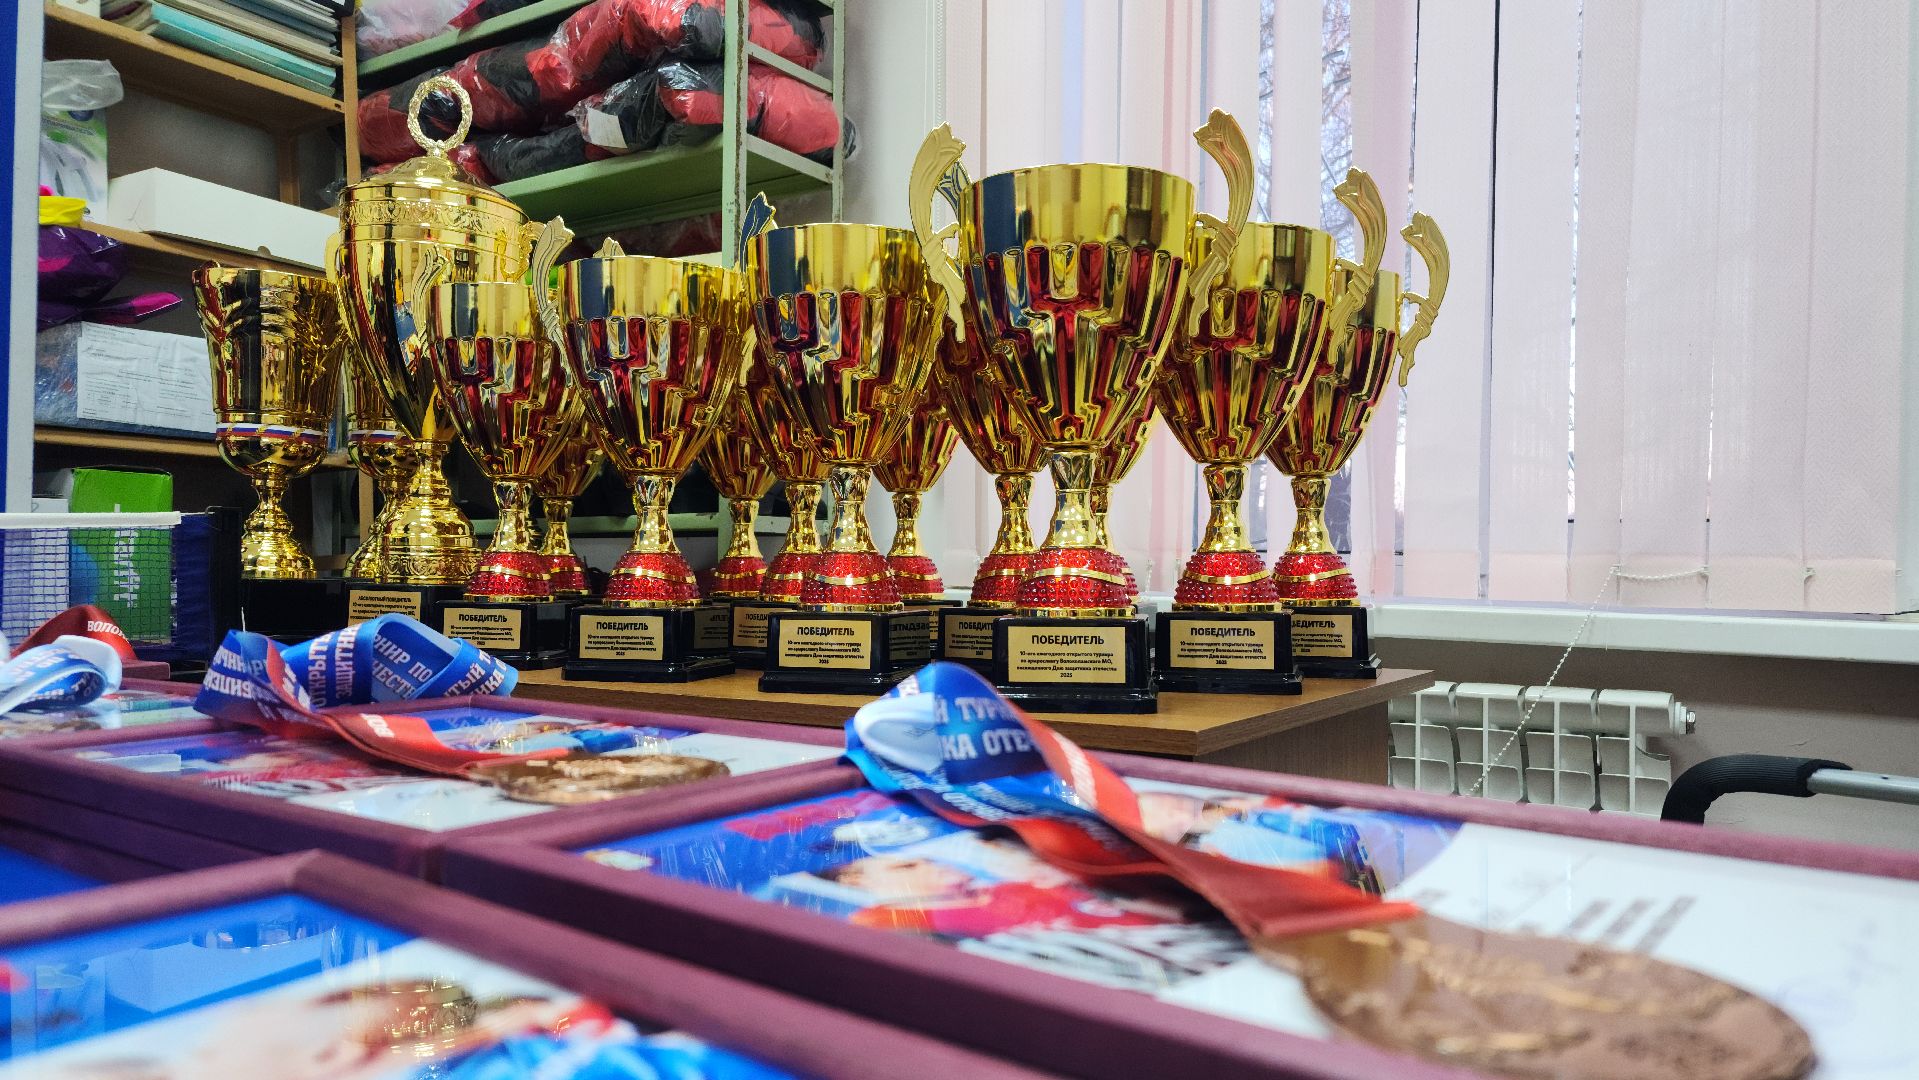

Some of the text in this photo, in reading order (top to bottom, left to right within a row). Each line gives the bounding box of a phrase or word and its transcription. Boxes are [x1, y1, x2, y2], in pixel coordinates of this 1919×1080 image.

[458, 613, 508, 623] ПОБЕДИТЕЛЬ
[596, 621, 649, 632] ПОБЕДИТЕЛЬ
[797, 626, 855, 637] ПОБЕДИТЕЛЬ
[1190, 627, 1256, 638] ПОБЕДИТЕЛЬ
[1031, 634, 1105, 646] ПОБЕДИТЕЛЬ
[408, 661, 434, 683] ПО
[982, 726, 1031, 757] ОТЕ
